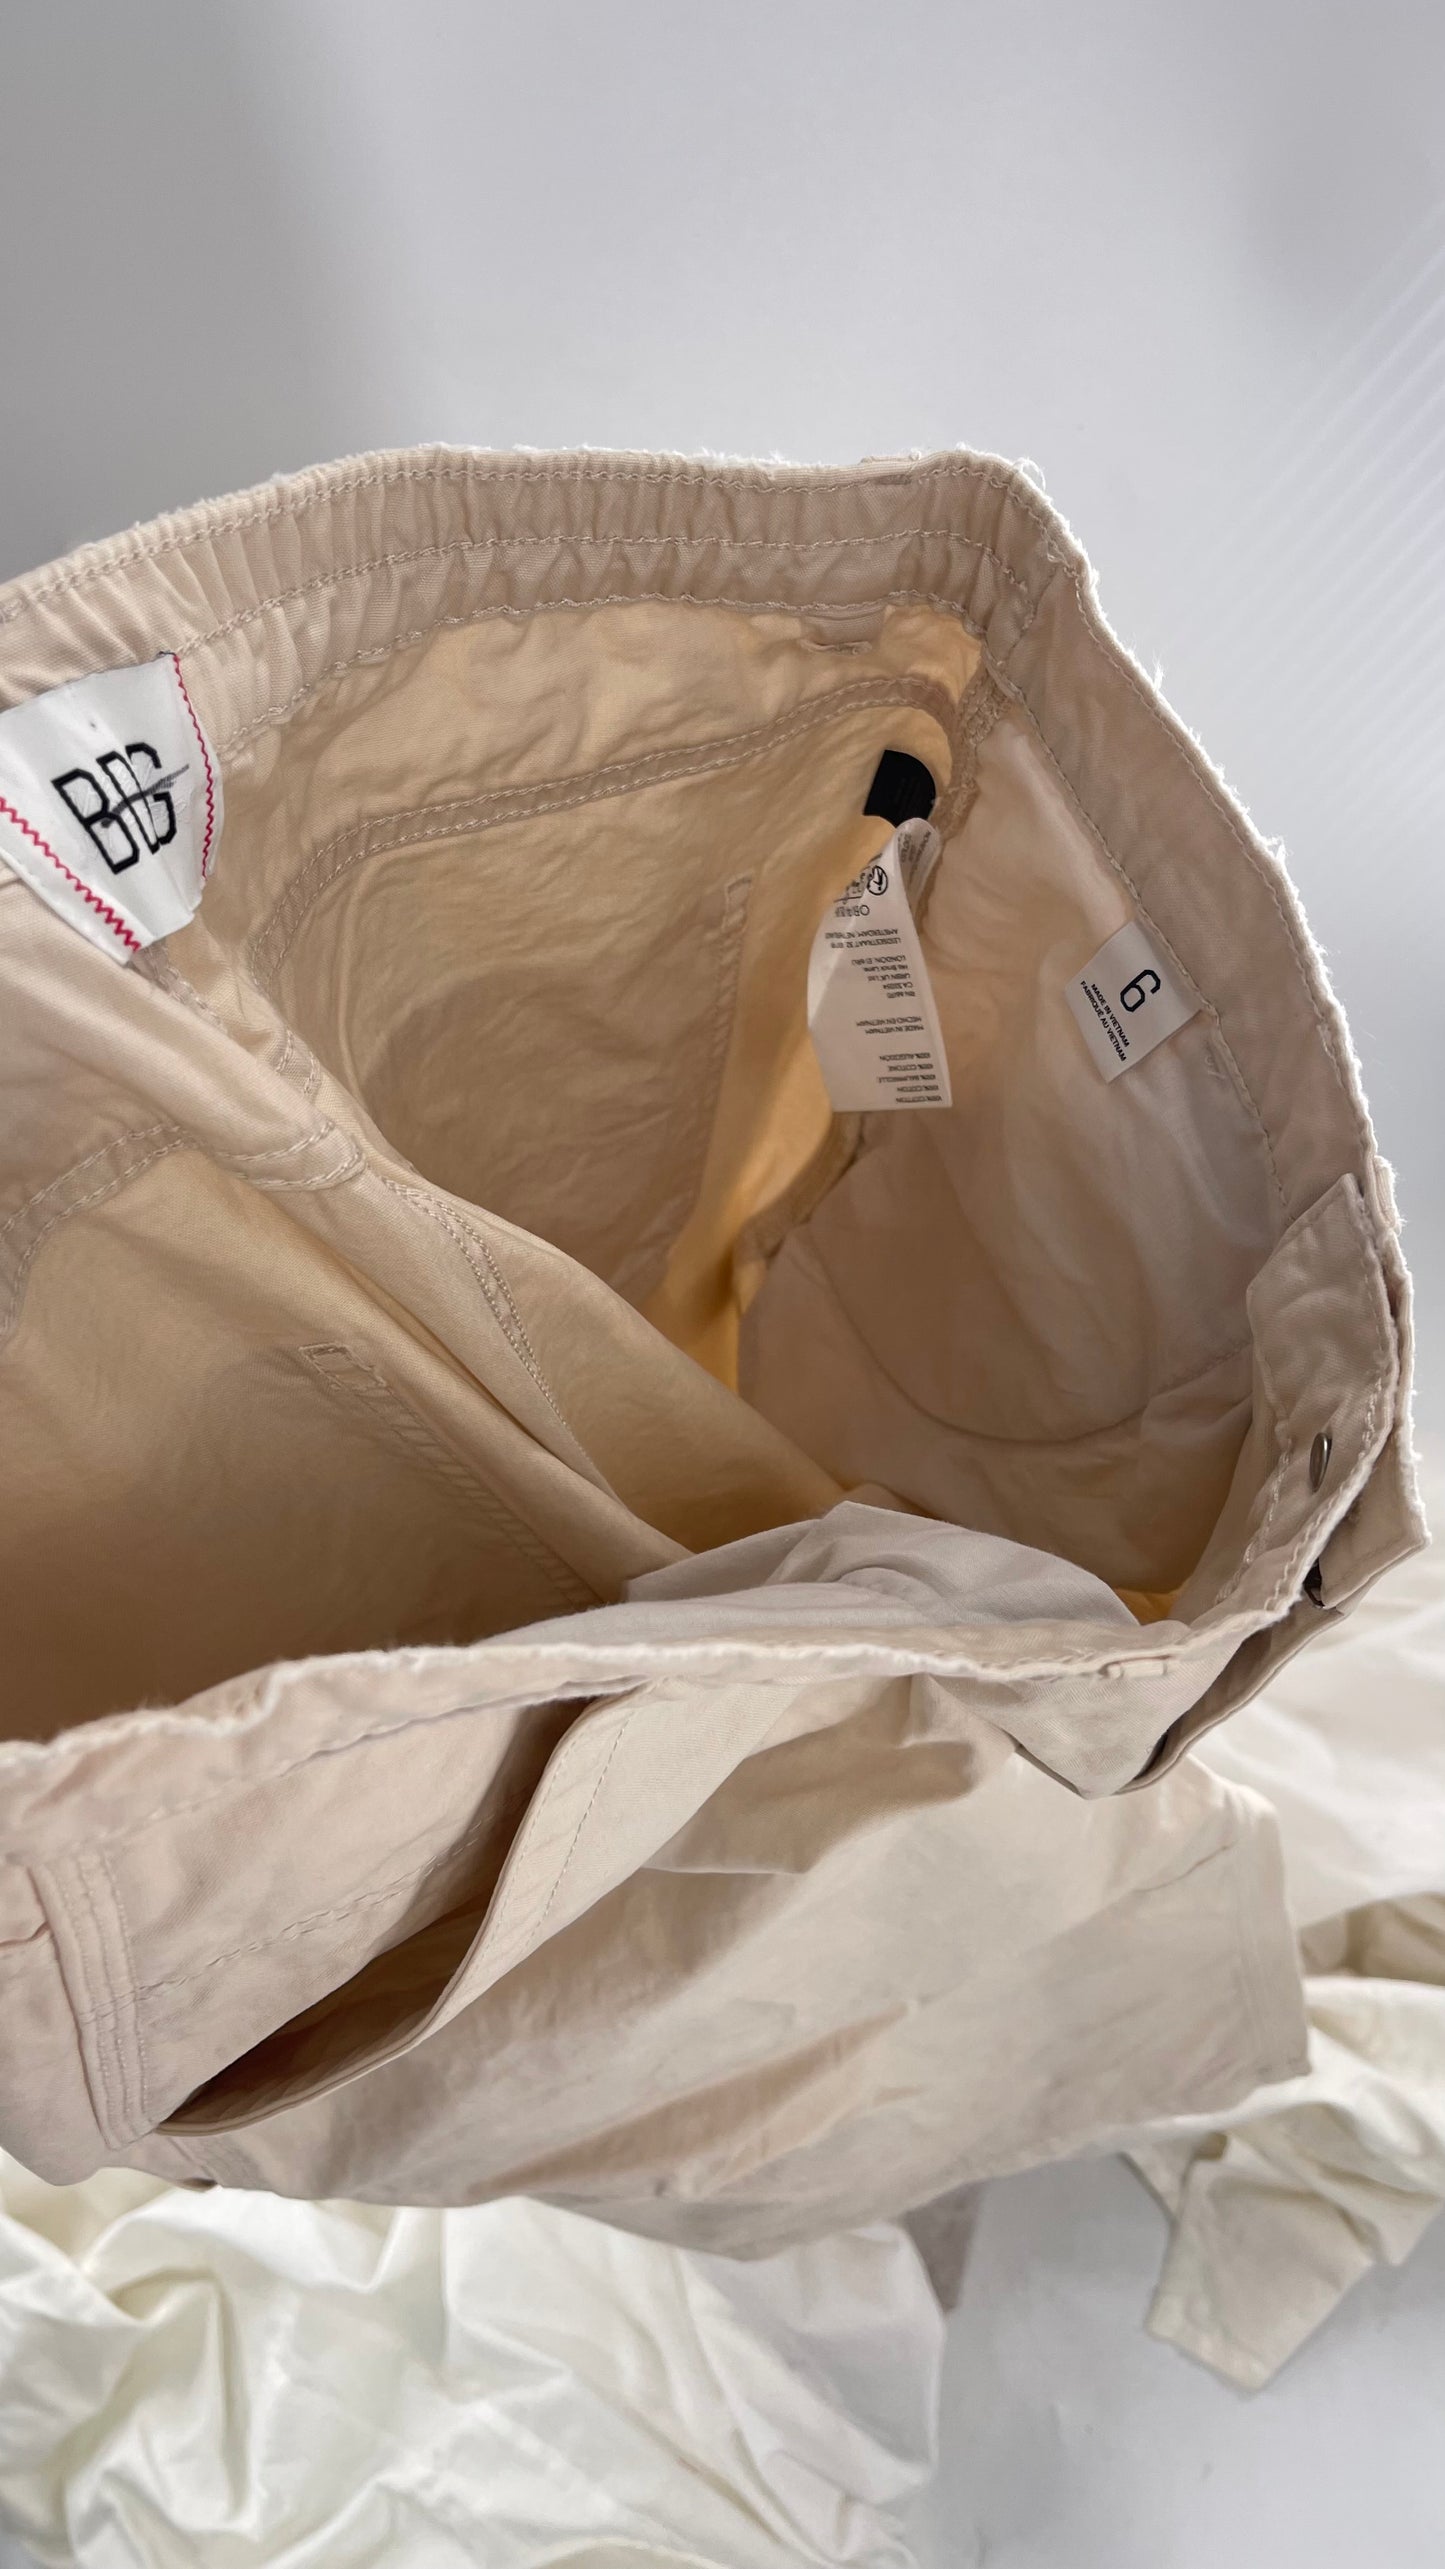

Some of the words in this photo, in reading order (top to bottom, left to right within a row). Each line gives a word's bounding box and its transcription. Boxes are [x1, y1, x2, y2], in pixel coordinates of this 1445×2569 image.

[1091, 984, 1106, 1006] MADE
[1104, 1005, 1112, 1014] IN
[1110, 1014, 1130, 1047] VIETNAM
[1100, 1018, 1109, 1028] AU
[1107, 1028, 1127, 1061] VIETNAM
